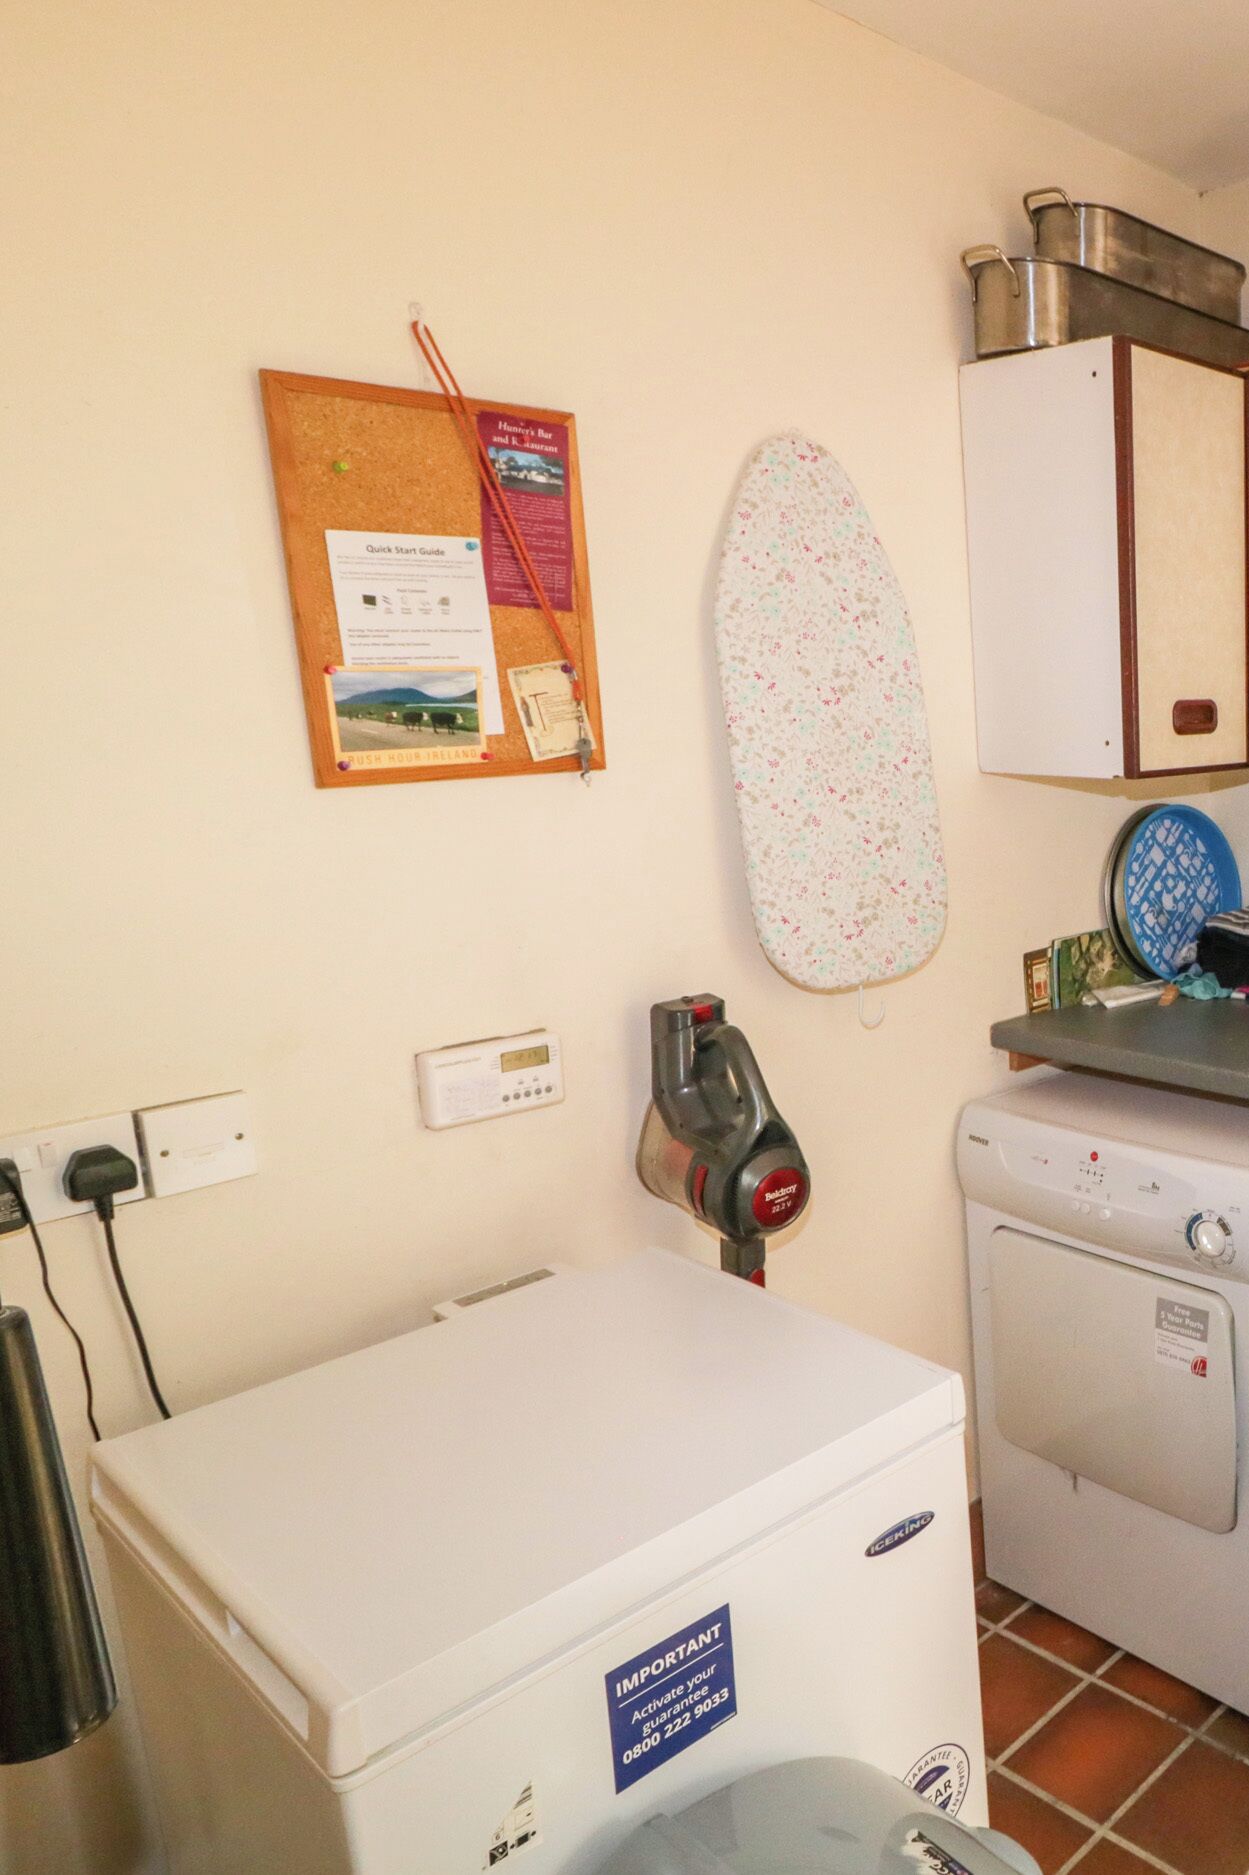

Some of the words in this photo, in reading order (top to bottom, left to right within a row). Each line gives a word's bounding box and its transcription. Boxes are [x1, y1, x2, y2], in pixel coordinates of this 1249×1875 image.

[492, 435, 509, 444] and
[498, 421, 535, 436] Hunter's
[537, 428, 553, 440] Bar
[365, 545, 393, 555] Quick
[394, 546, 417, 555] Start
[419, 547, 446, 557] Guide
[348, 754, 382, 766] RUSH
[389, 751, 421, 763] HOUR
[427, 749, 477, 761] IRELAND
[765, 1184, 797, 1201] Beldray
[1174, 1305, 1191, 1317] Free
[1162, 1321, 1201, 1338] Guarantee
[1167, 1312, 1183, 1324] Year
[1185, 1318, 1204, 1330] Parts
[870, 1514, 932, 1554] ICEKING
[615, 1622, 722, 1698] IMPORTANT
[631, 1683, 684, 1724] Activate
[686, 1664, 717, 1693] your
[642, 1685, 709, 1737] guarantee
[622, 1731, 661, 1765] 0800
[664, 1711, 692, 1739] 222
[694, 1687, 730, 1719] 9033
[909, 1750, 951, 1785] ARANTEE
